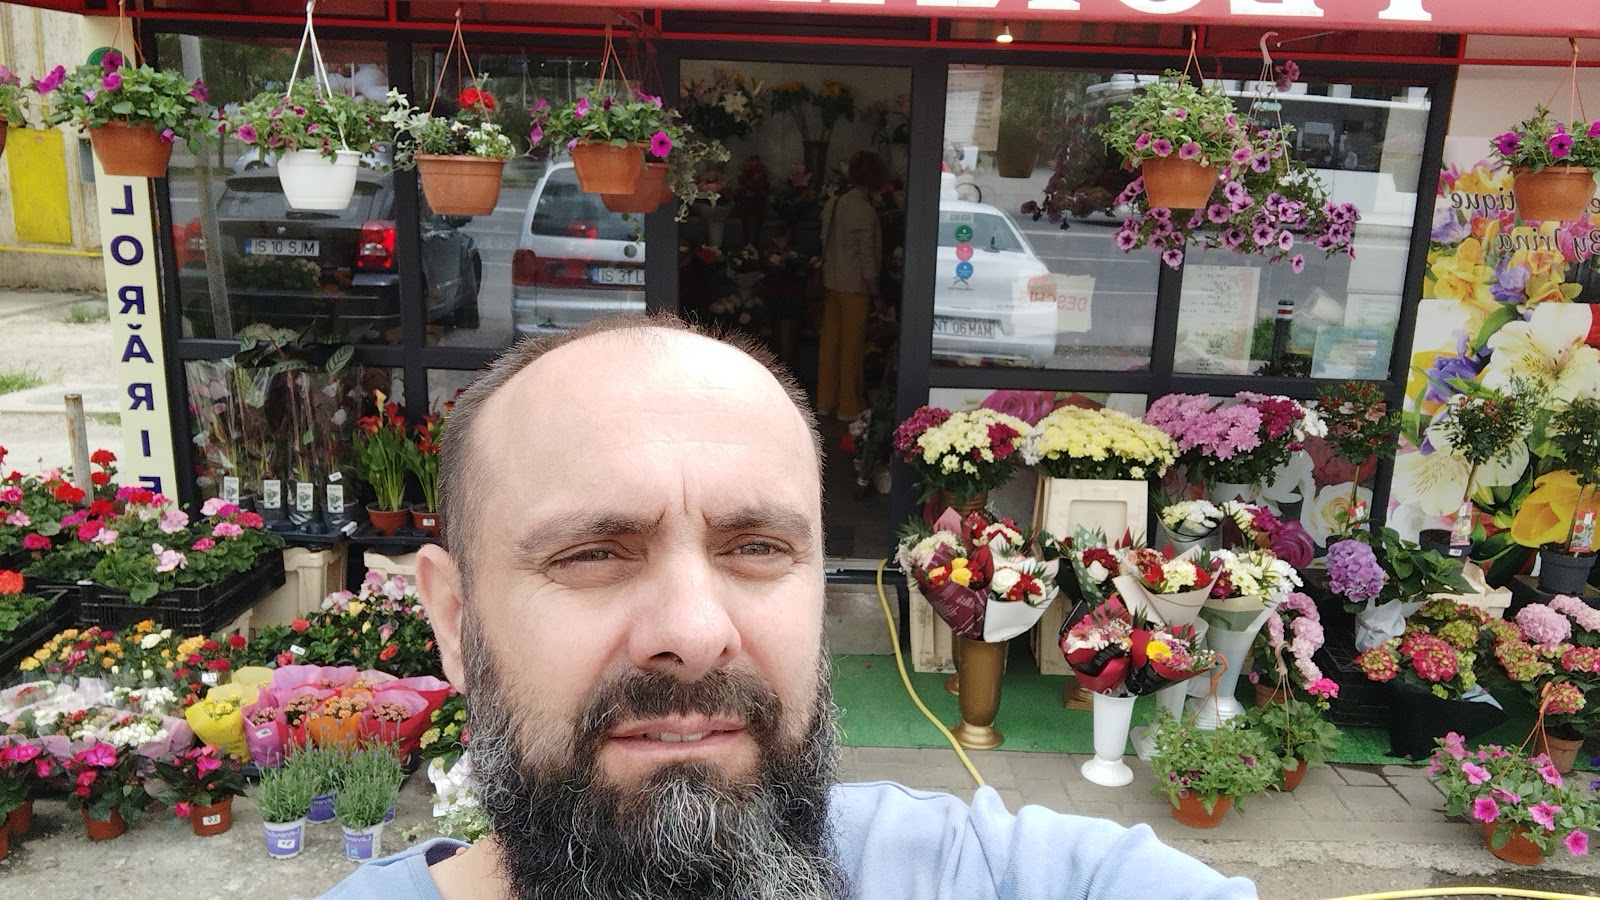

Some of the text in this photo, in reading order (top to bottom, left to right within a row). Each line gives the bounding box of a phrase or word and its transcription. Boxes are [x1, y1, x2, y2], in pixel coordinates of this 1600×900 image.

[254, 241, 315, 254] IS 10 SJM
[601, 270, 613, 282] IS
[952, 321, 967, 335] 06
[968, 322, 992, 337] MAM
